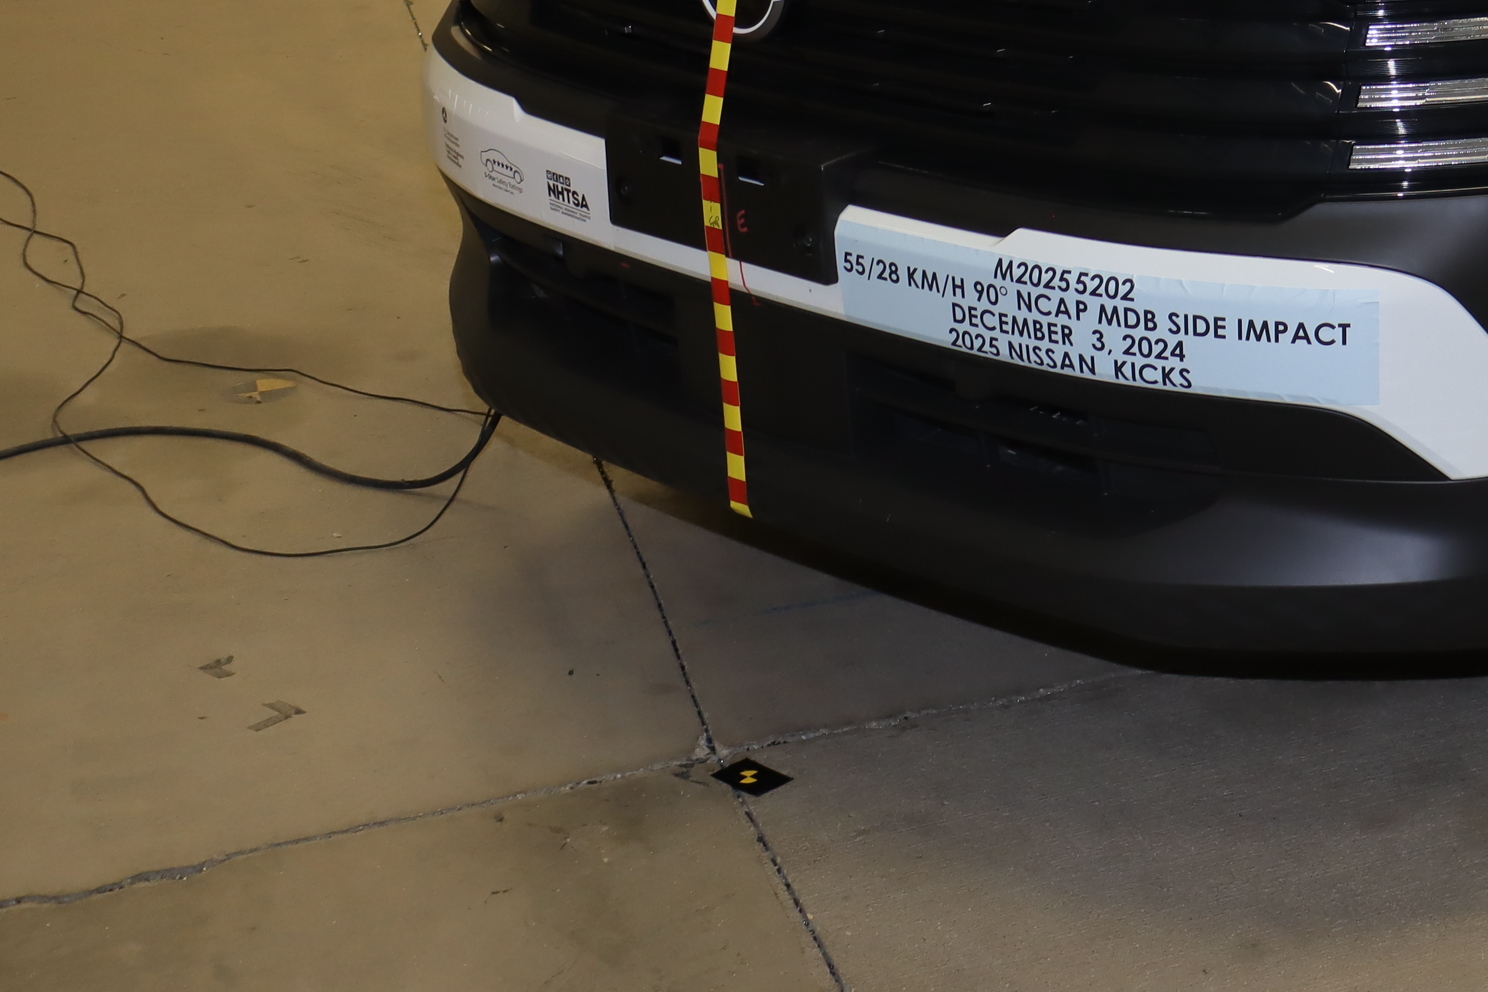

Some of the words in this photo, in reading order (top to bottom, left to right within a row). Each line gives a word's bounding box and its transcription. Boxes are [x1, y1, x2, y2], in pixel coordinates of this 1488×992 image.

[547, 181, 590, 211] NHTSA
[843, 251, 900, 284] 55/28
[907, 266, 966, 299] KM/H
[973, 280, 1008, 306] 90°
[1016, 289, 1088, 321] NCAP
[1098, 303, 1158, 332] MDB
[1168, 312, 1227, 340] SIDE
[1236, 319, 1351, 346] IMPACT
[993, 257, 1135, 302] M20255202
[949, 327, 1000, 357] 2025
[1008, 340, 1096, 376] NISSAN
[1114, 359, 1193, 389] KICKS
[951, 302, 1074, 347] DECEMBER
[1091, 329, 1113, 356] 3,
[1122, 334, 1186, 362] 2024
